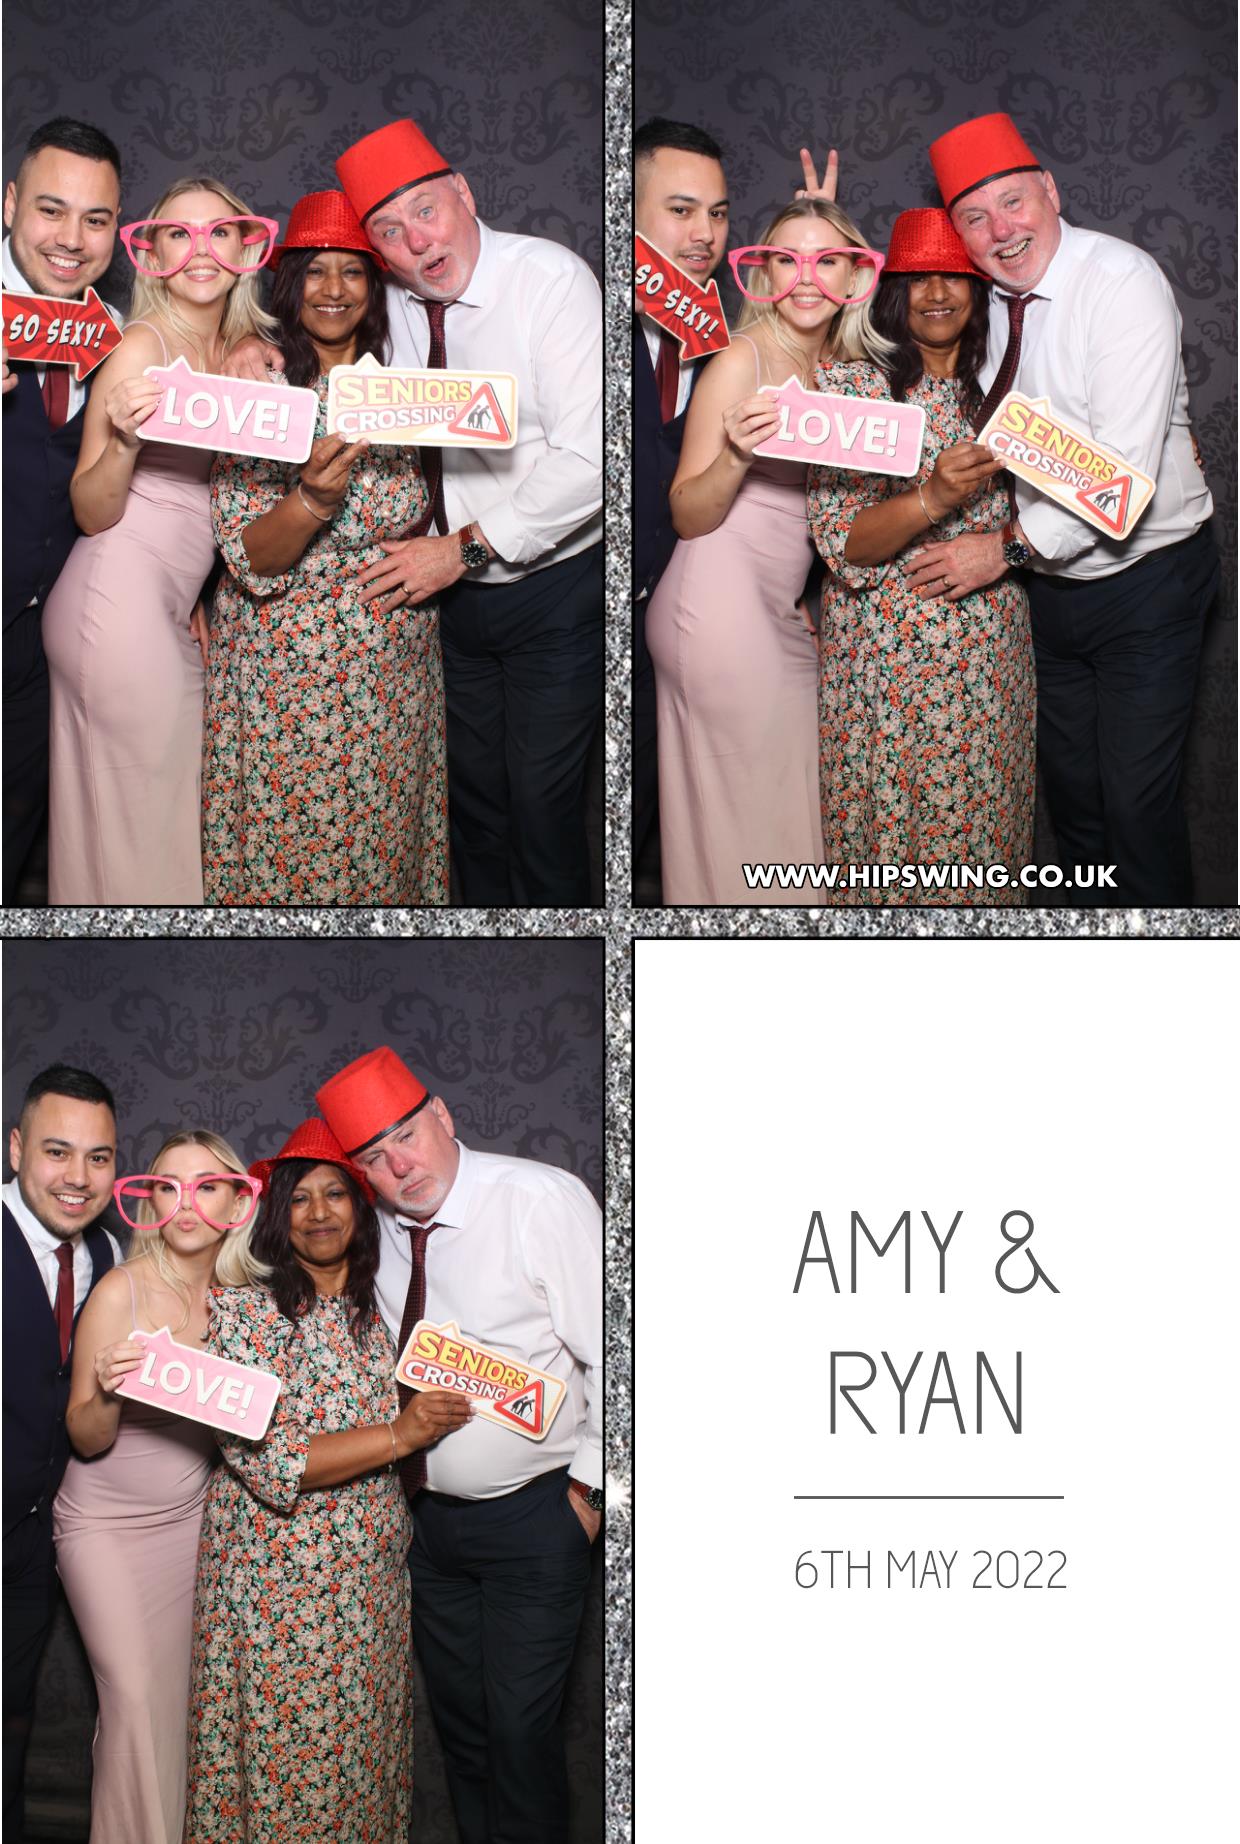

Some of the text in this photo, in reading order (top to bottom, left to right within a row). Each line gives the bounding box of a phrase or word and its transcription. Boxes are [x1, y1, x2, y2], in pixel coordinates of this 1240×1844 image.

[635, 264, 719, 339] SO SEXY!
[9, 313, 107, 348] SO SEXY!
[163, 387, 291, 443] LOVE!
[335, 374, 472, 407] SENIORS
[335, 404, 457, 436] CROSSING
[778, 405, 899, 457] LOVE!
[1001, 401, 1117, 482] SENIORS
[988, 431, 1092, 490] CROSSING
[139, 1352, 254, 1420] LOVE!
[404, 1360, 507, 1401] CROSSING
[413, 1330, 528, 1391] SENIORS
